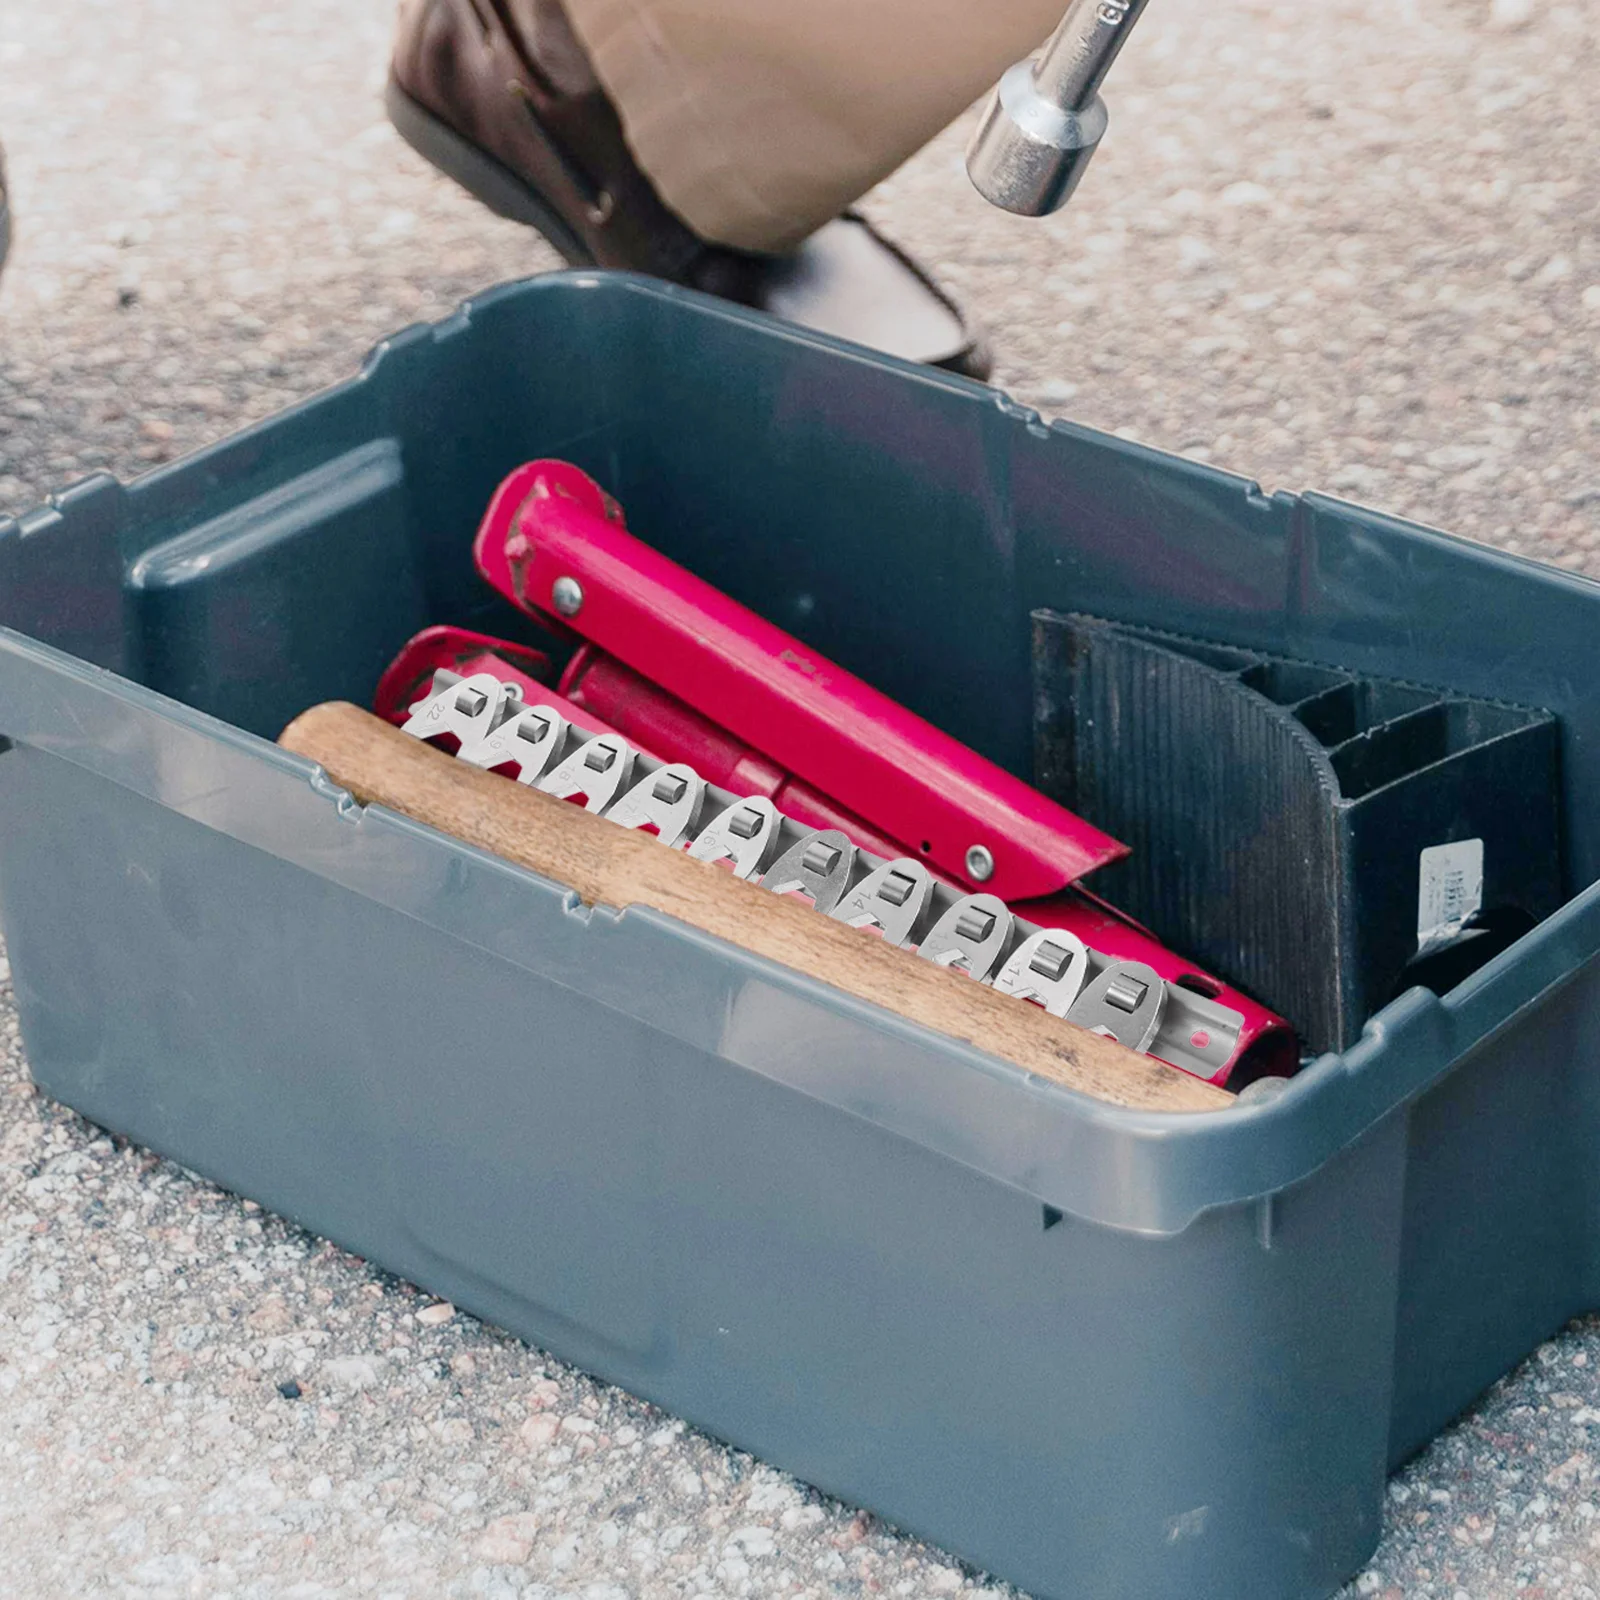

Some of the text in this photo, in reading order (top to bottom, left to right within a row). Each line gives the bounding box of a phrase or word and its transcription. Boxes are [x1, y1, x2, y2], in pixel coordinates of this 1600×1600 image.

[426, 703, 446, 721] 22
[490, 733, 506, 750] 19
[559, 765, 575, 781] 18
[703, 829, 720, 846] 16
[851, 891, 872, 910] 14
[1001, 968, 1020, 987] 11
